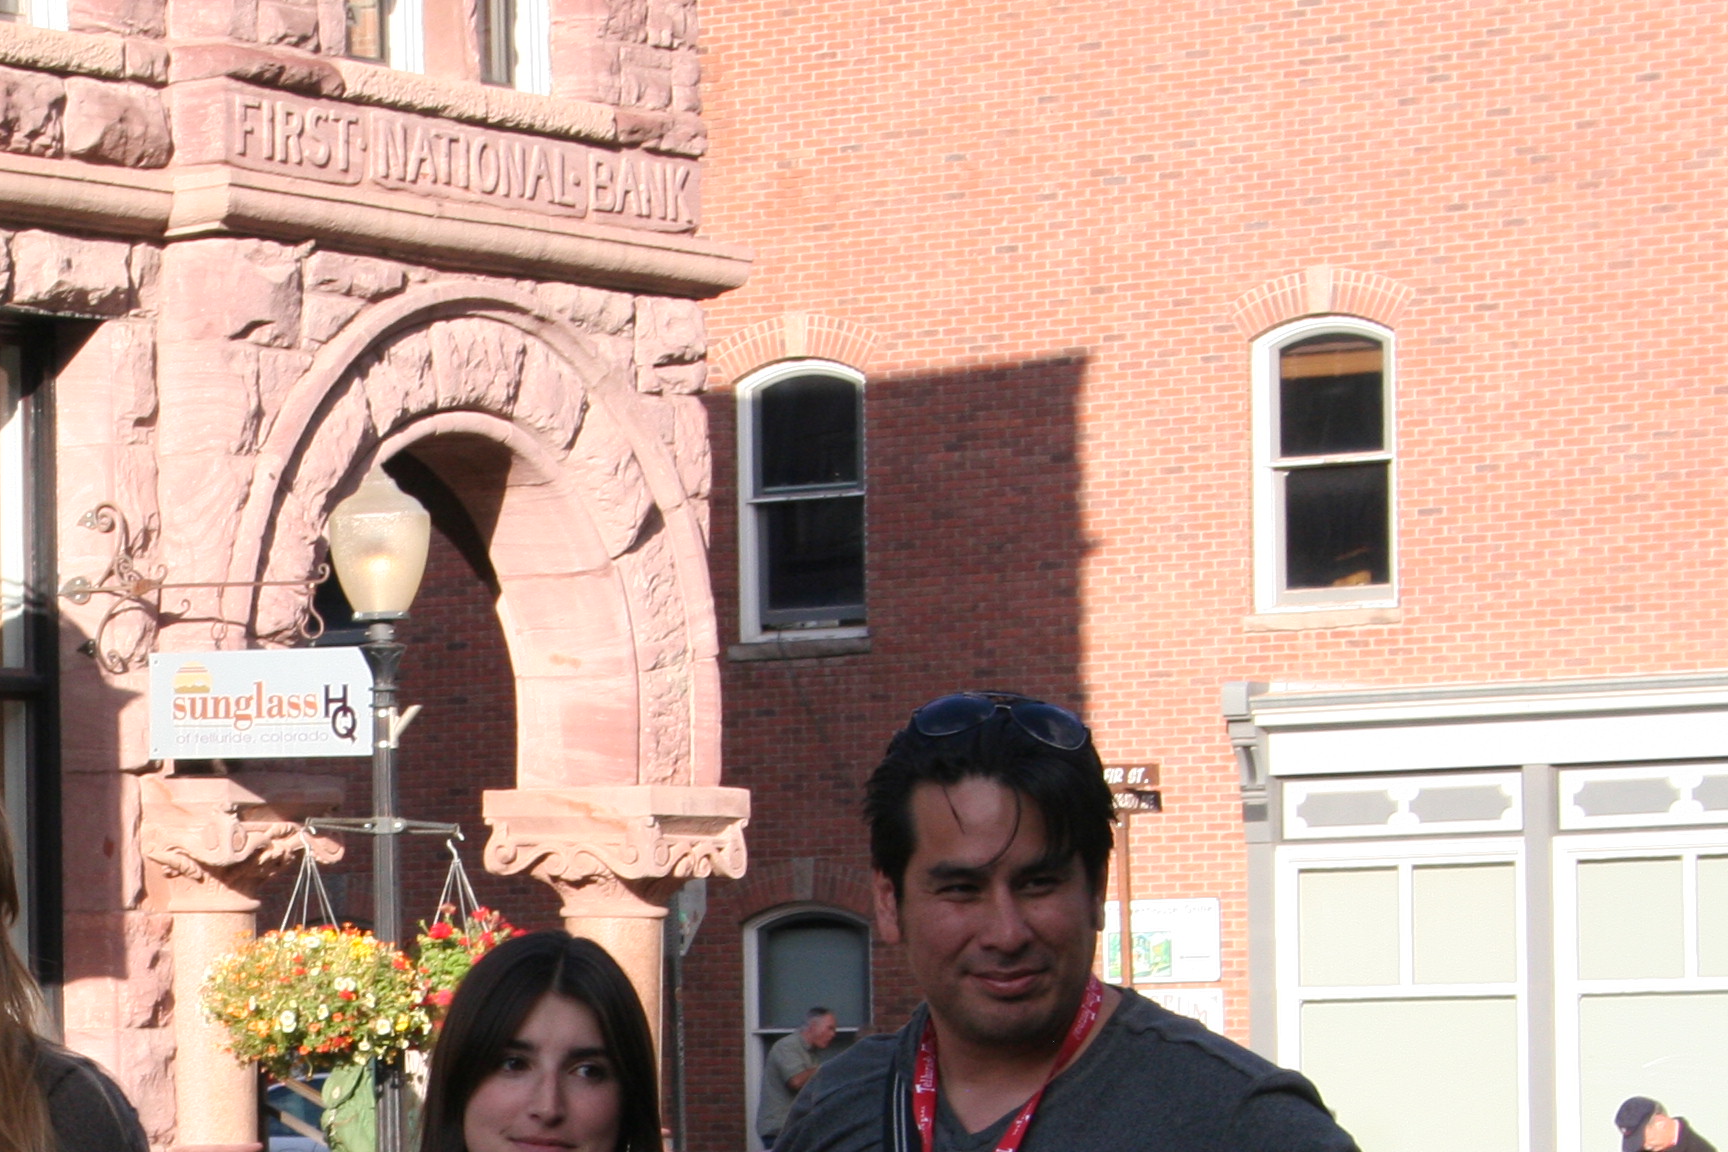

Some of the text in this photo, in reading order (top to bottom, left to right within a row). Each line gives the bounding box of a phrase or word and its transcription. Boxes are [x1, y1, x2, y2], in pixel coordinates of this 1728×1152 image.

[235, 96, 696, 224] FIRST NATIONAL BANK
[173, 680, 319, 731] sunglass
[175, 731, 192, 744] of
[260, 730, 329, 744] colorado
[1127, 767, 1149, 784] ST.
